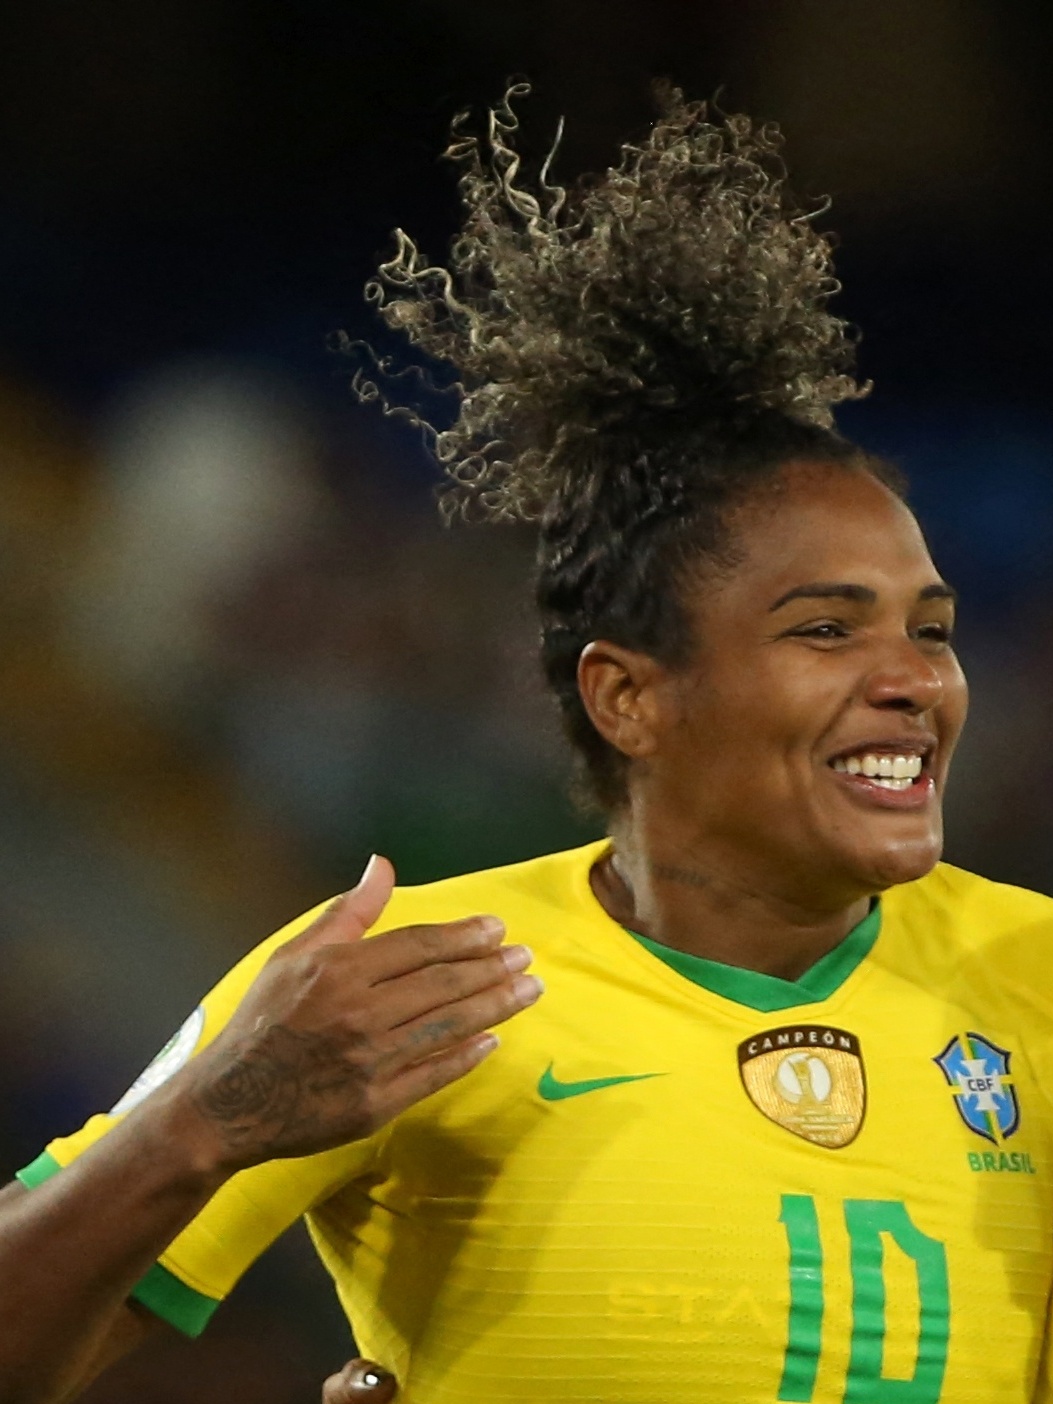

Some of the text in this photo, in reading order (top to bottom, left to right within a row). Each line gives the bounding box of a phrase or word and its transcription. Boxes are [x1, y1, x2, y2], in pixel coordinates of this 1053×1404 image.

[748, 1031, 851, 1055] CAMPEÓN
[967, 1079, 994, 1092] CBF
[967, 1151, 1037, 1175] BRASIL
